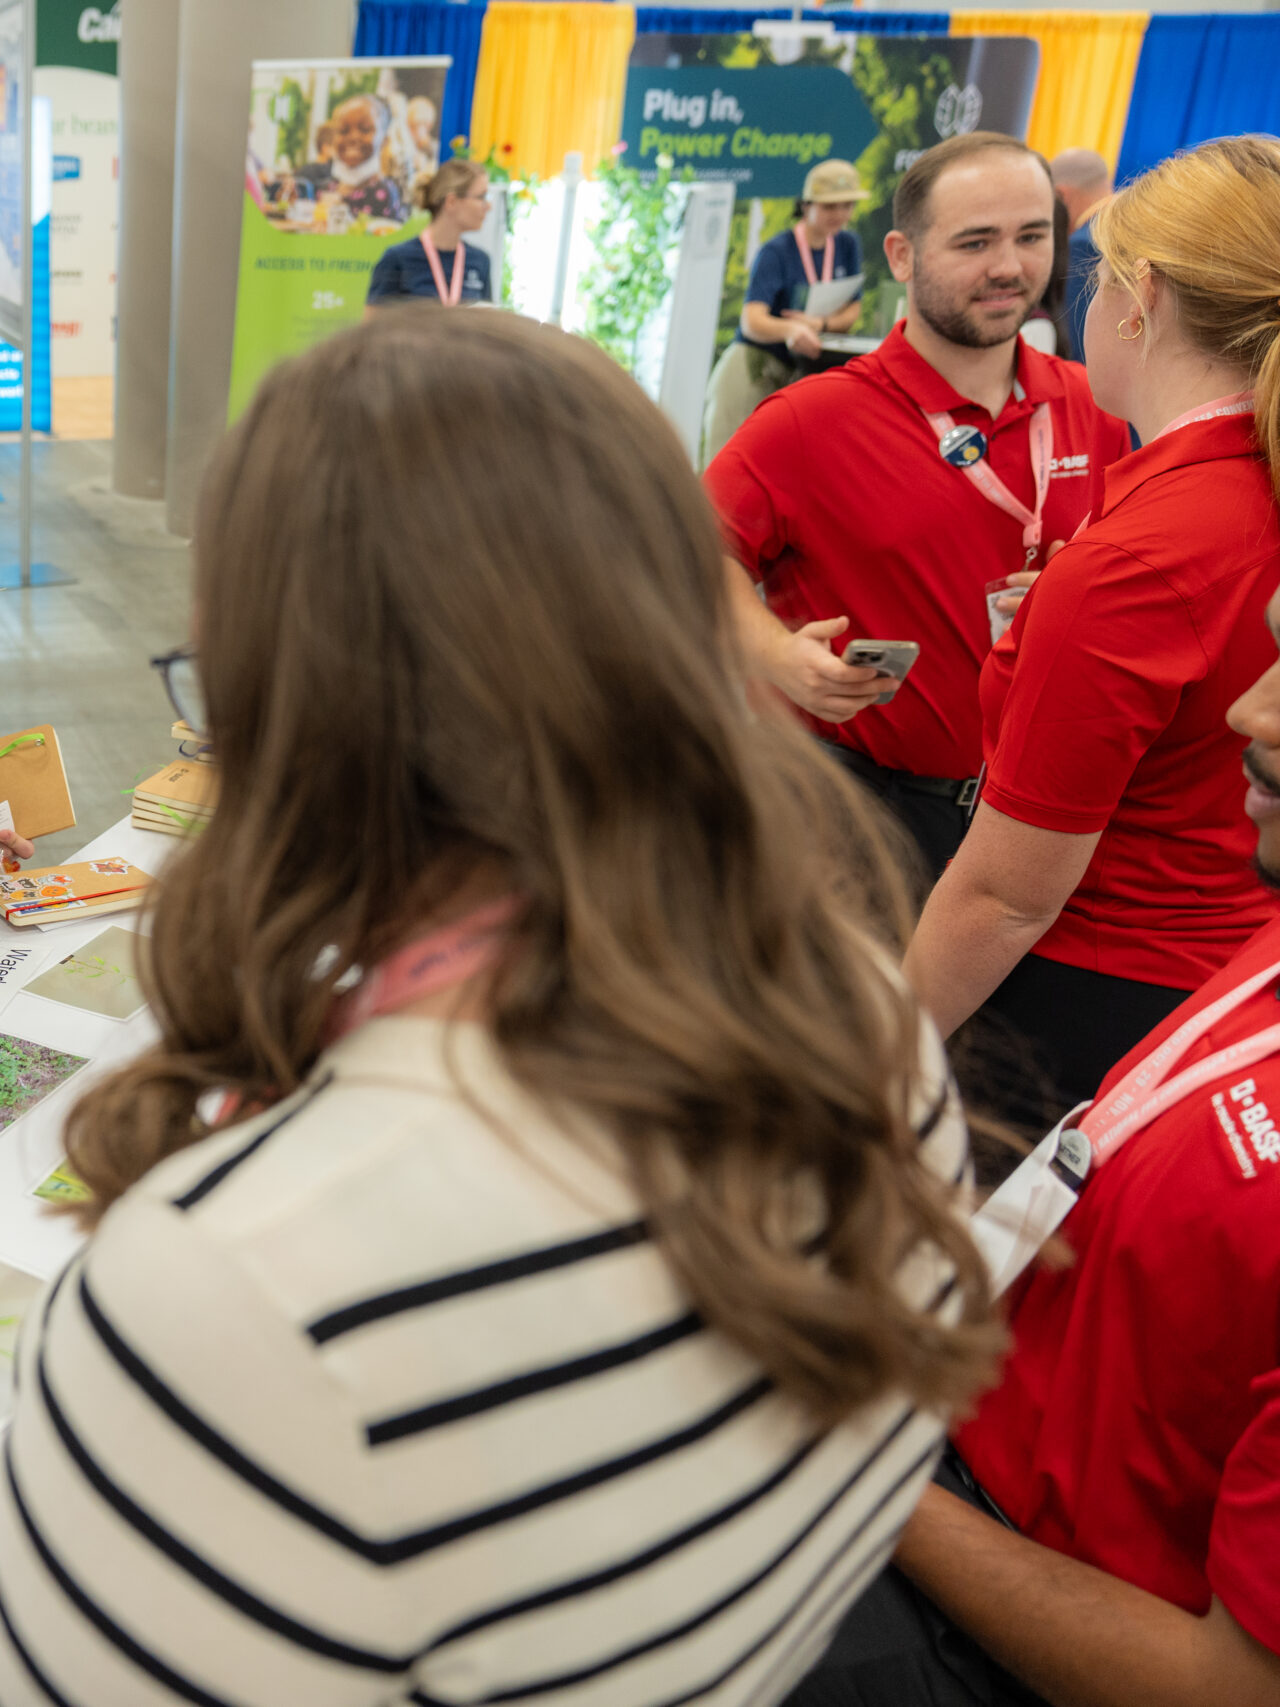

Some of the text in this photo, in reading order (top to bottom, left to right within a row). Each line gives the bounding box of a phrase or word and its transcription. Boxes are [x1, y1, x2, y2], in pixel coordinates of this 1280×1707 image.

[643, 88, 745, 128] Plug in,
[639, 127, 833, 164] Power Change
[254, 256, 305, 271] ACCESS
[308, 257, 325, 272] TO
